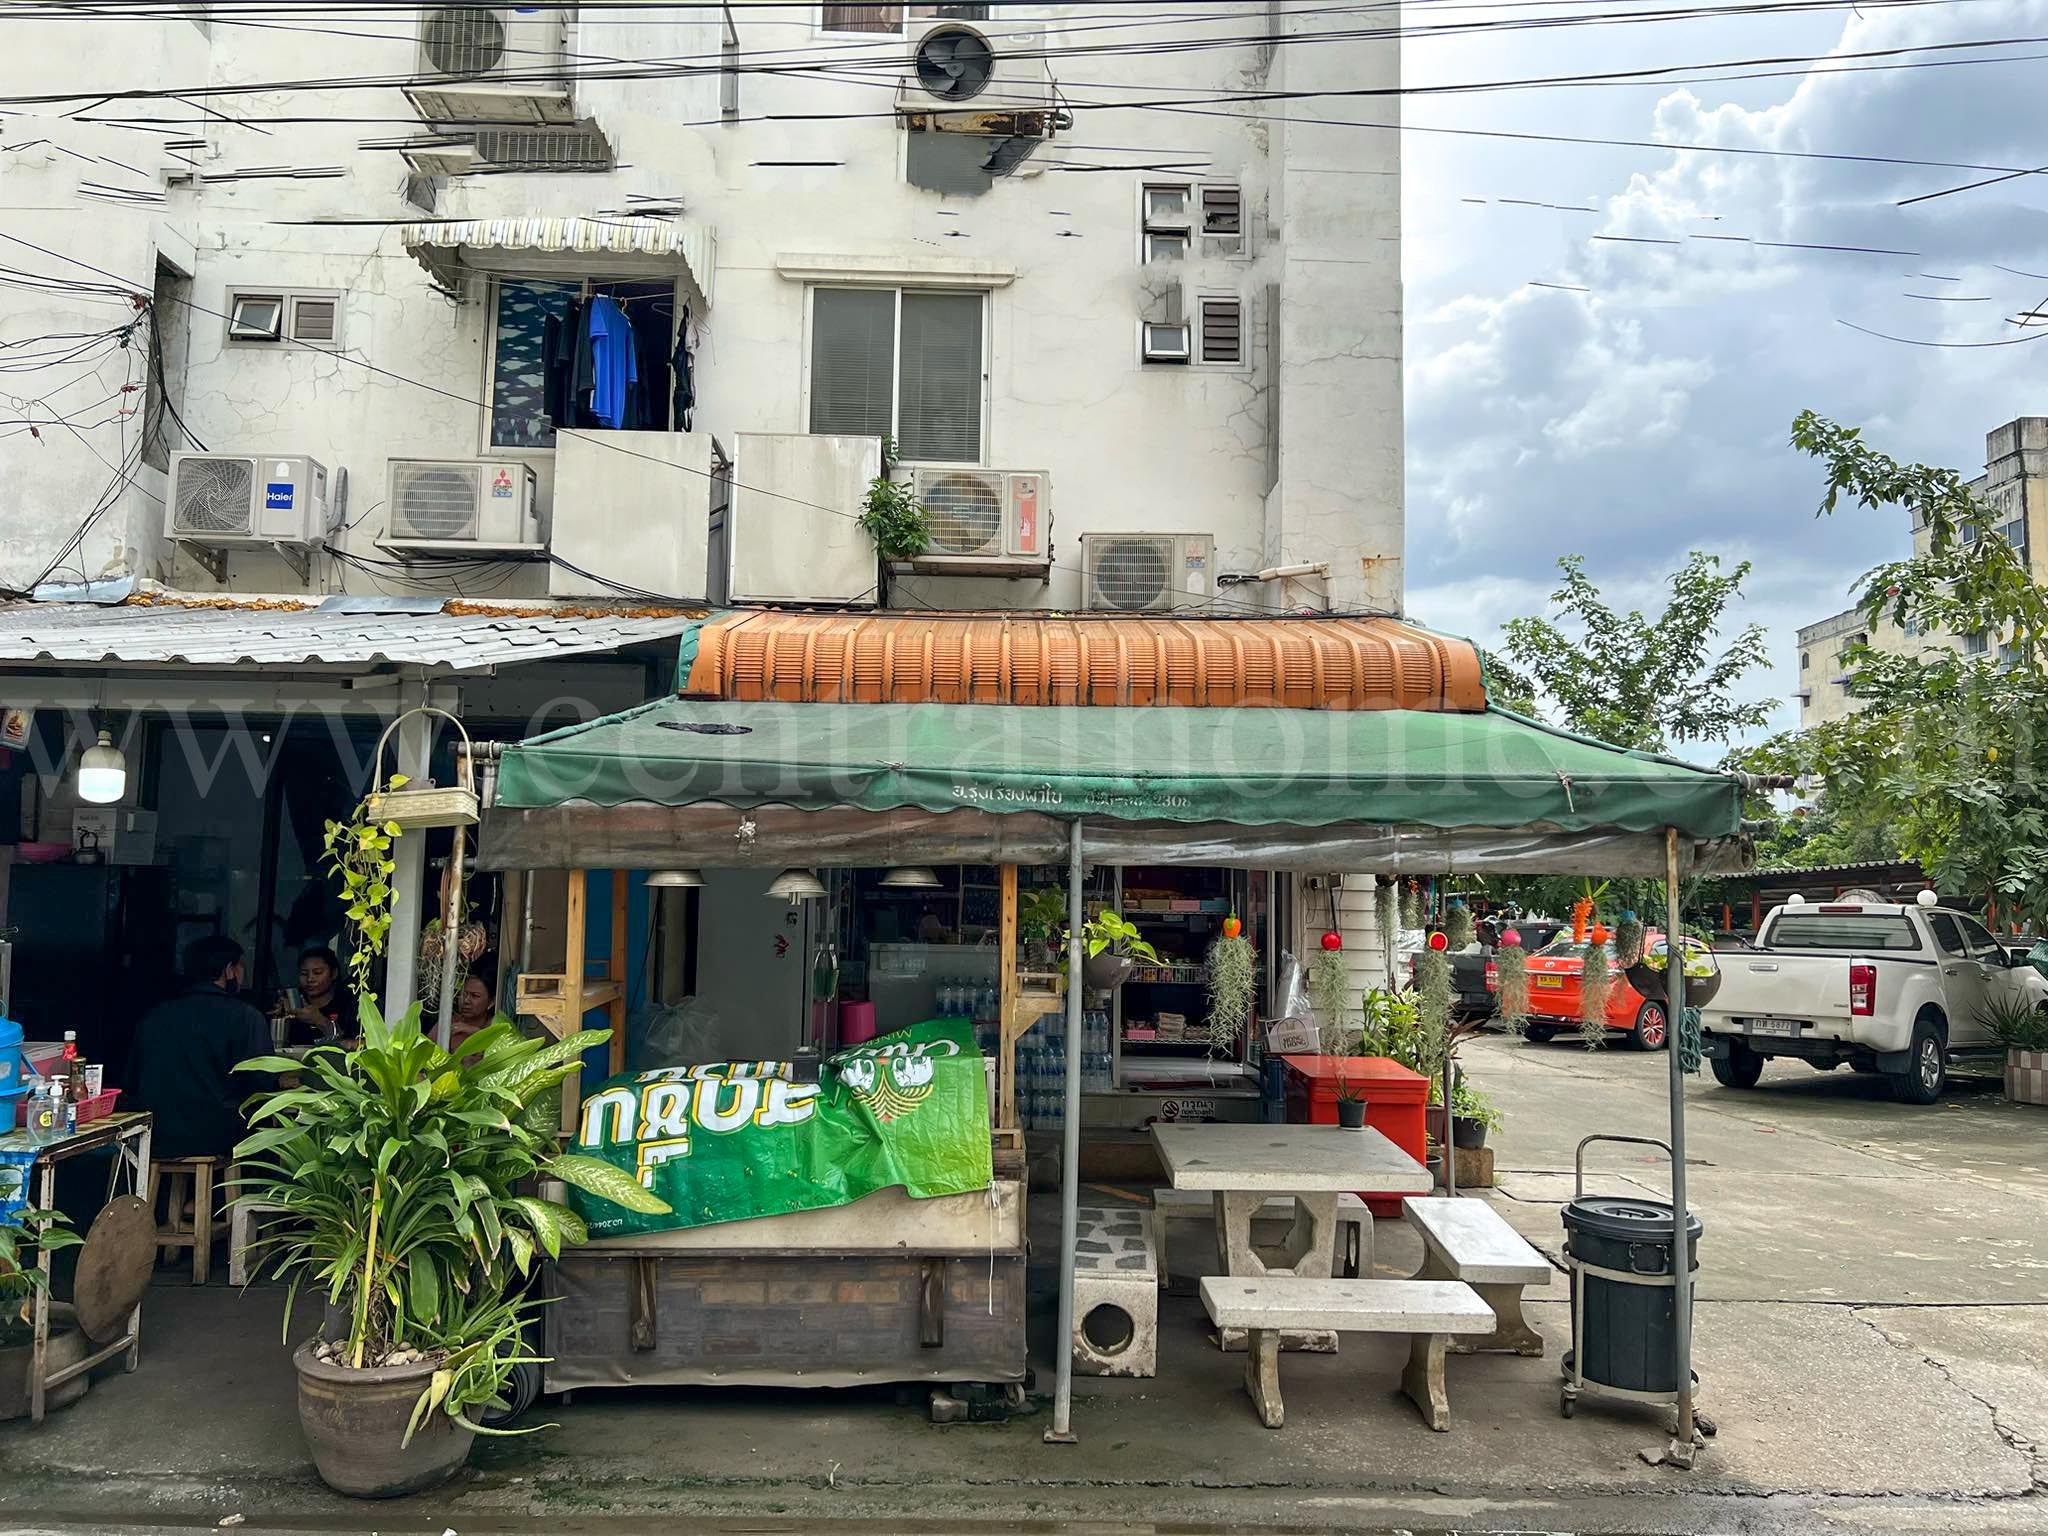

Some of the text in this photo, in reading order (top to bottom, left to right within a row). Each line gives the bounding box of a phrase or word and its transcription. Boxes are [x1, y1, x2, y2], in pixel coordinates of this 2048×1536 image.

[267, 492, 293, 501] Haier
[579, 1078, 822, 1189] สดชื่น
